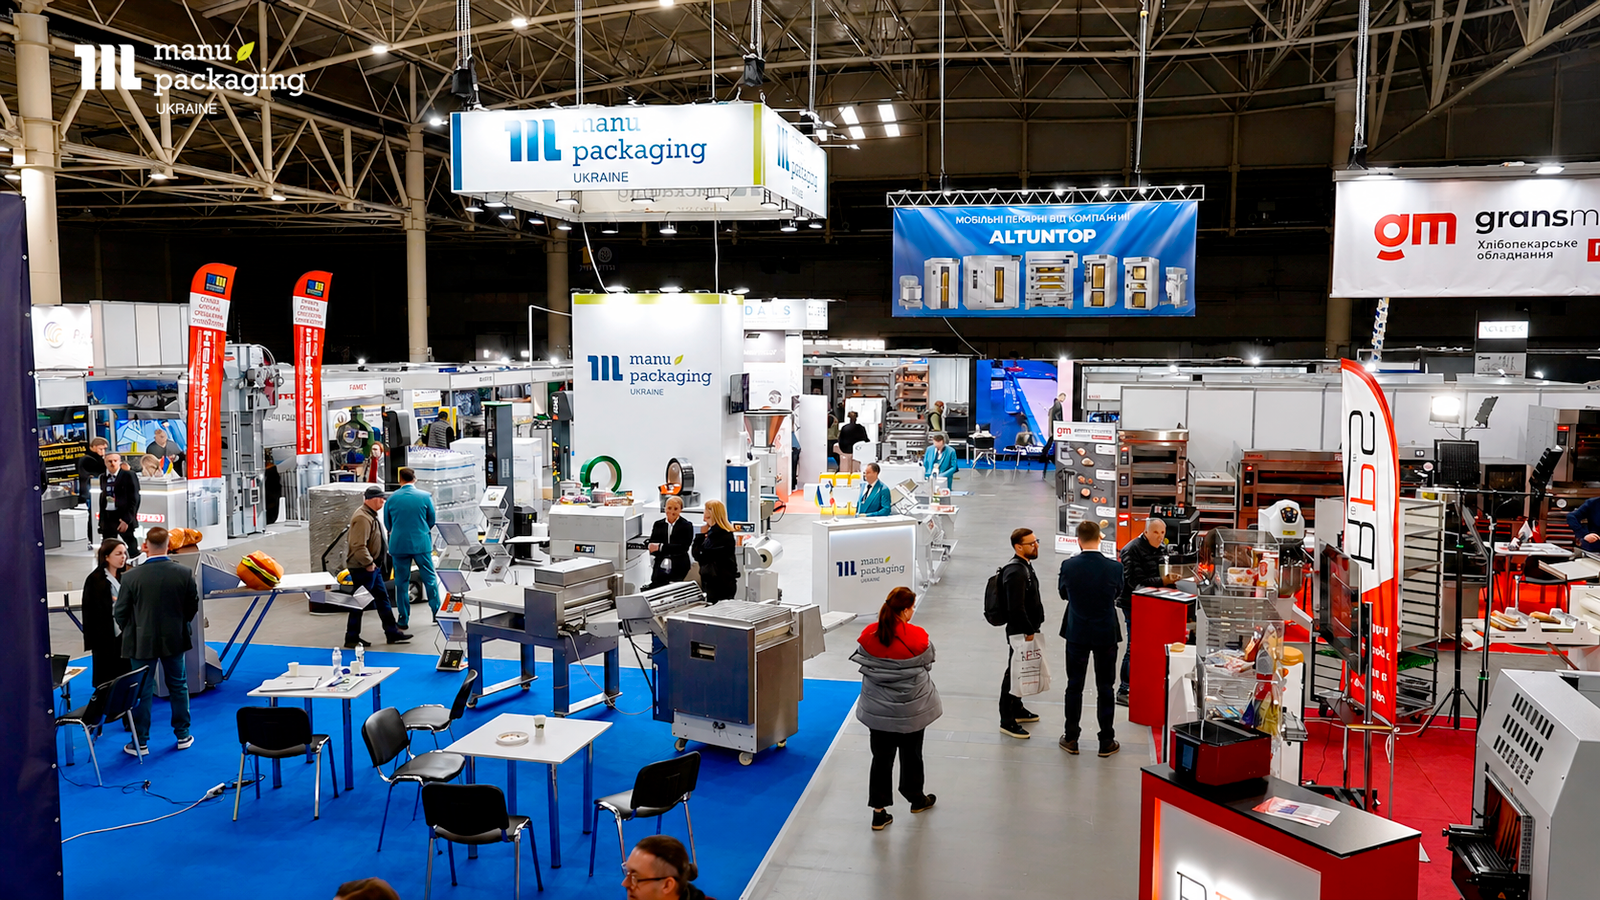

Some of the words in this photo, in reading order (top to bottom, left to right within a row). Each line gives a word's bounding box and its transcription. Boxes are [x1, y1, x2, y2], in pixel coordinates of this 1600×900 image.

[573, 116, 641, 132] manu
[572, 138, 707, 166] packaging
[573, 172, 629, 183] UKRAINE
[955, 215, 1003, 224] МОБІЛЬНІ
[1006, 214, 1048, 224] ПЕКАРНІ
[989, 229, 1097, 245] ALTUNTOP
[1374, 212, 1457, 261] gm
[1478, 239, 1578, 250] Хлібопекарське
[1477, 251, 1554, 261] обладнання
[630, 354, 671, 365] manu
[630, 369, 712, 386] packaging
[630, 388, 664, 396] UKRAINE
[1057, 427, 1071, 437] gm
[861, 557, 884, 566] manu
[860, 564, 905, 577] packaging
